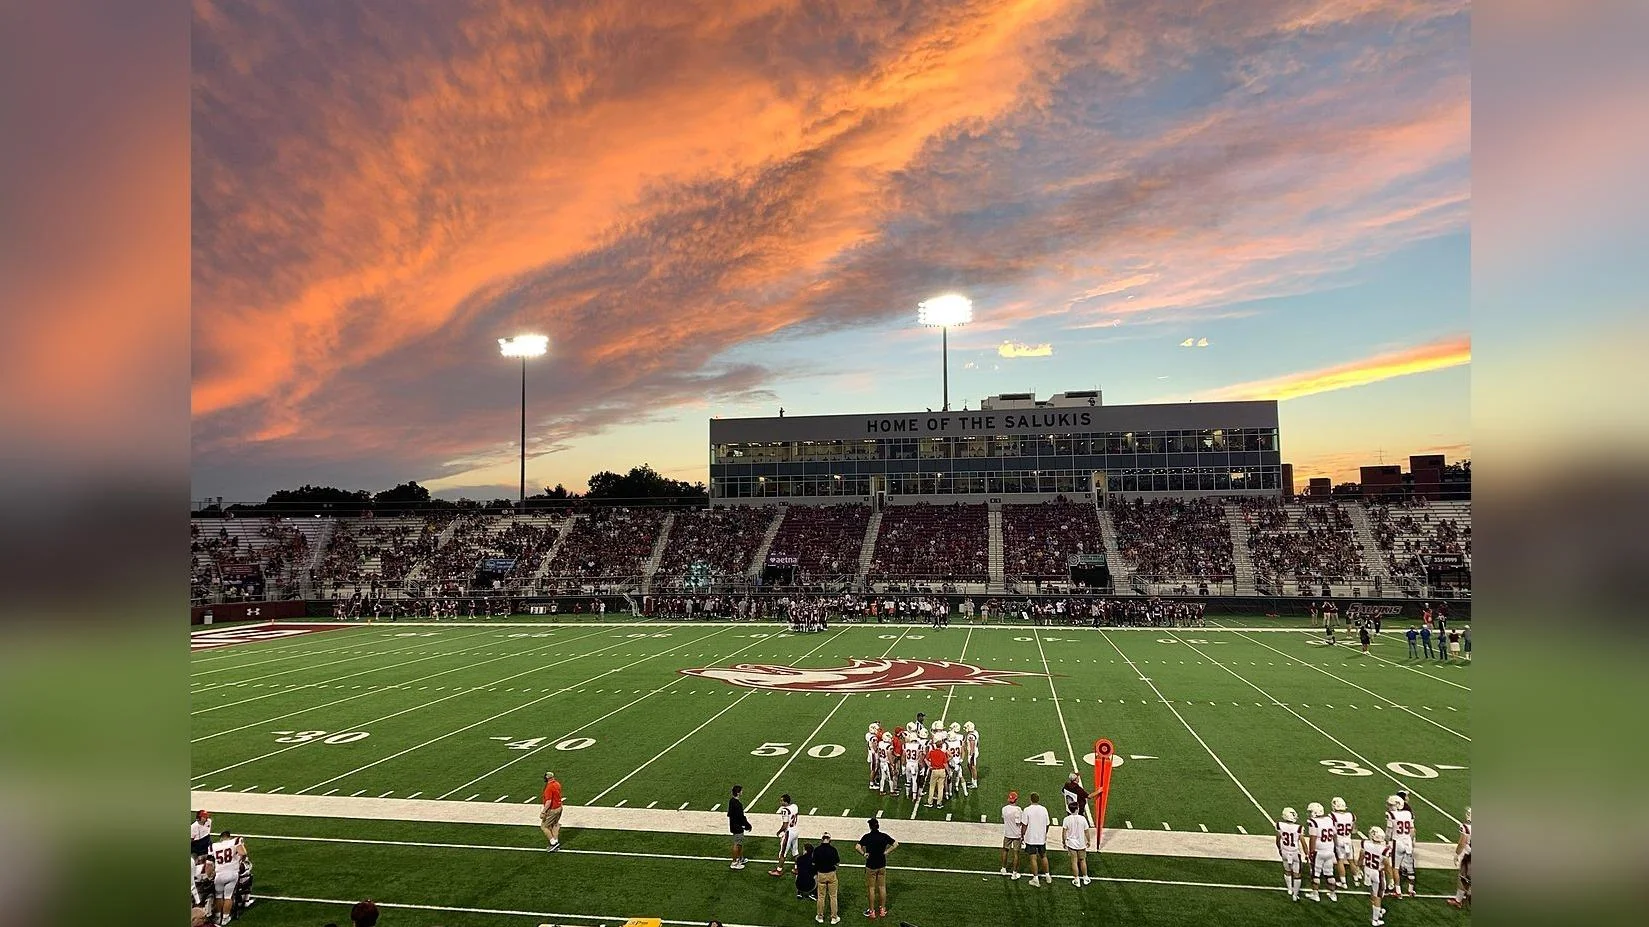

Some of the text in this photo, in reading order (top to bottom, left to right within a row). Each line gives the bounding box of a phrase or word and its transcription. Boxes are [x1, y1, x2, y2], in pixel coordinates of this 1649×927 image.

[867, 412, 1092, 433] HOME OF THE SALUKIS
[775, 556, 798, 564] aetna
[274, 730, 370, 744] 30
[503, 736, 597, 751] 40
[750, 742, 847, 759] 50
[906, 749, 917, 761] 33
[1319, 760, 1440, 779] 30
[1337, 823, 1352, 837] 26
[1396, 820, 1411, 835] 39
[1282, 831, 1296, 848] 31
[1321, 828, 1334, 843] 66
[215, 847, 233, 865] 58
[1364, 850, 1380, 871] 25
